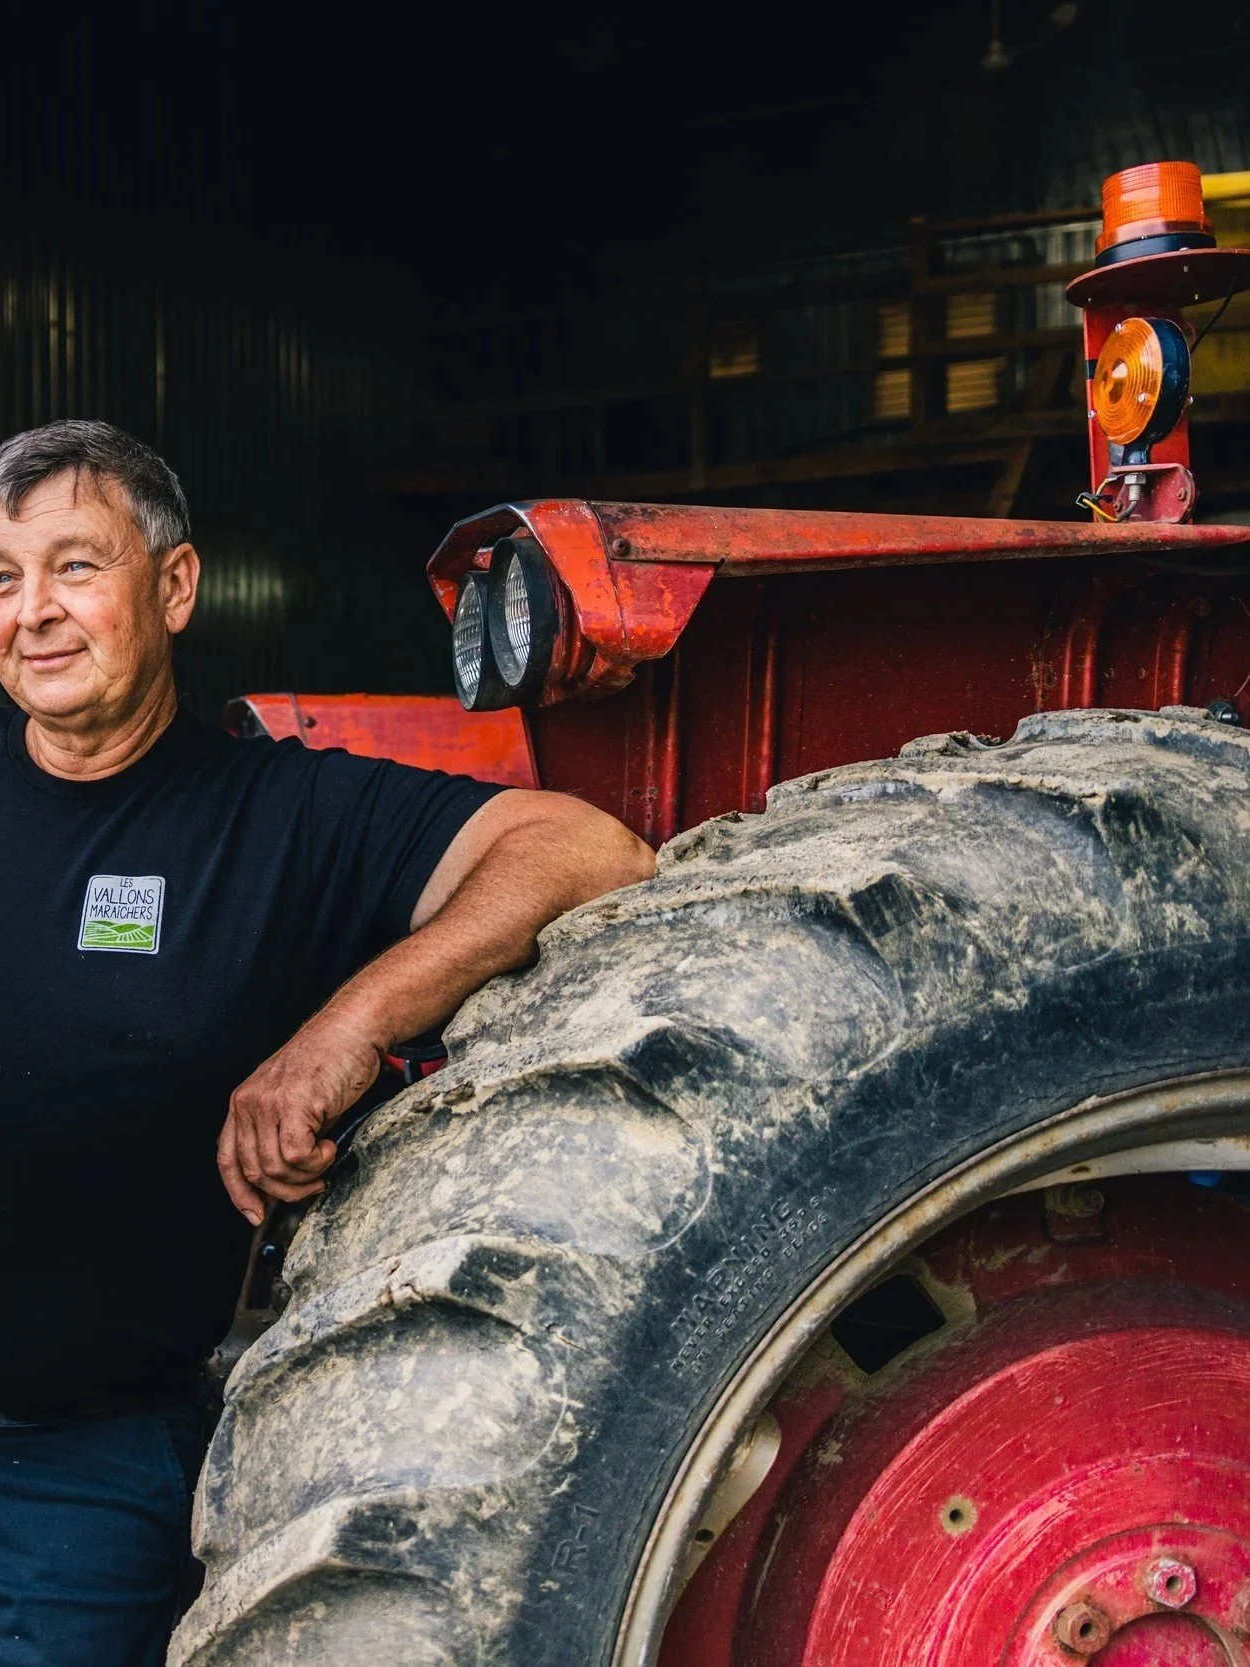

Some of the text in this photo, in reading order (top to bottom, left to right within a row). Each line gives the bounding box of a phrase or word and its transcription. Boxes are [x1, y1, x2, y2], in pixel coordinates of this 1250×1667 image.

[94, 887, 154, 904] VALLONS
[120, 878, 133, 887] LES
[89, 904, 153, 920] MARAÎCHERS
[670, 1196, 791, 1332] WARNING
[670, 1315, 713, 1373] NEVER
[551, 1503, 600, 1572] R-1
